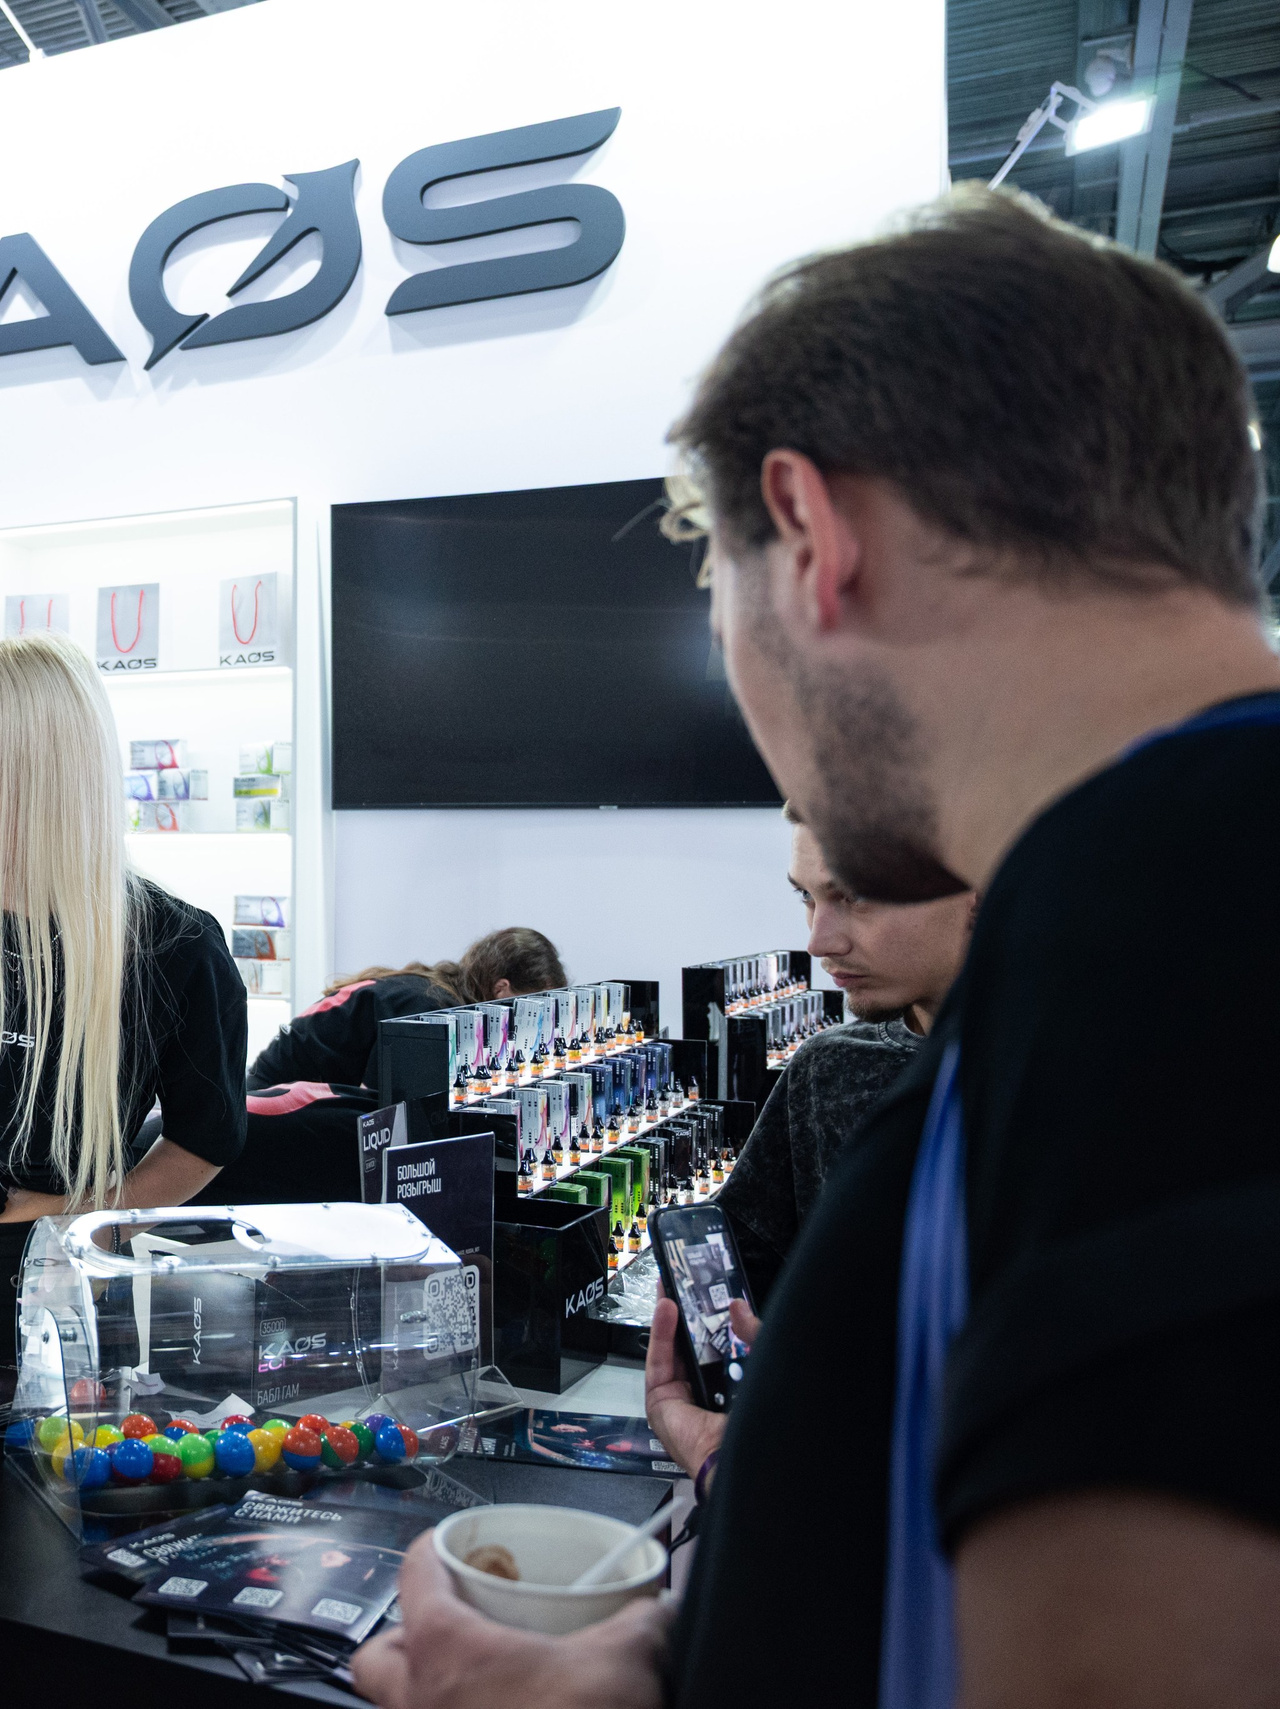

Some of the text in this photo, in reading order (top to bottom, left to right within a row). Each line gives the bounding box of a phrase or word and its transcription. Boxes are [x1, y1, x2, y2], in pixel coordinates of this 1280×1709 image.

[363, 1127, 391, 1151] LIQUID
[397, 1158, 436, 1181] БОЛЬШОЙ
[397, 1178, 442, 1199] РОЗЫГРЫШ
[257, 1383, 300, 1406] БАБЛ ГАМ
[242, 1501, 342, 1521] СВЯЖИТЕСЬ
[249, 1510, 302, 1524] НАМИ
